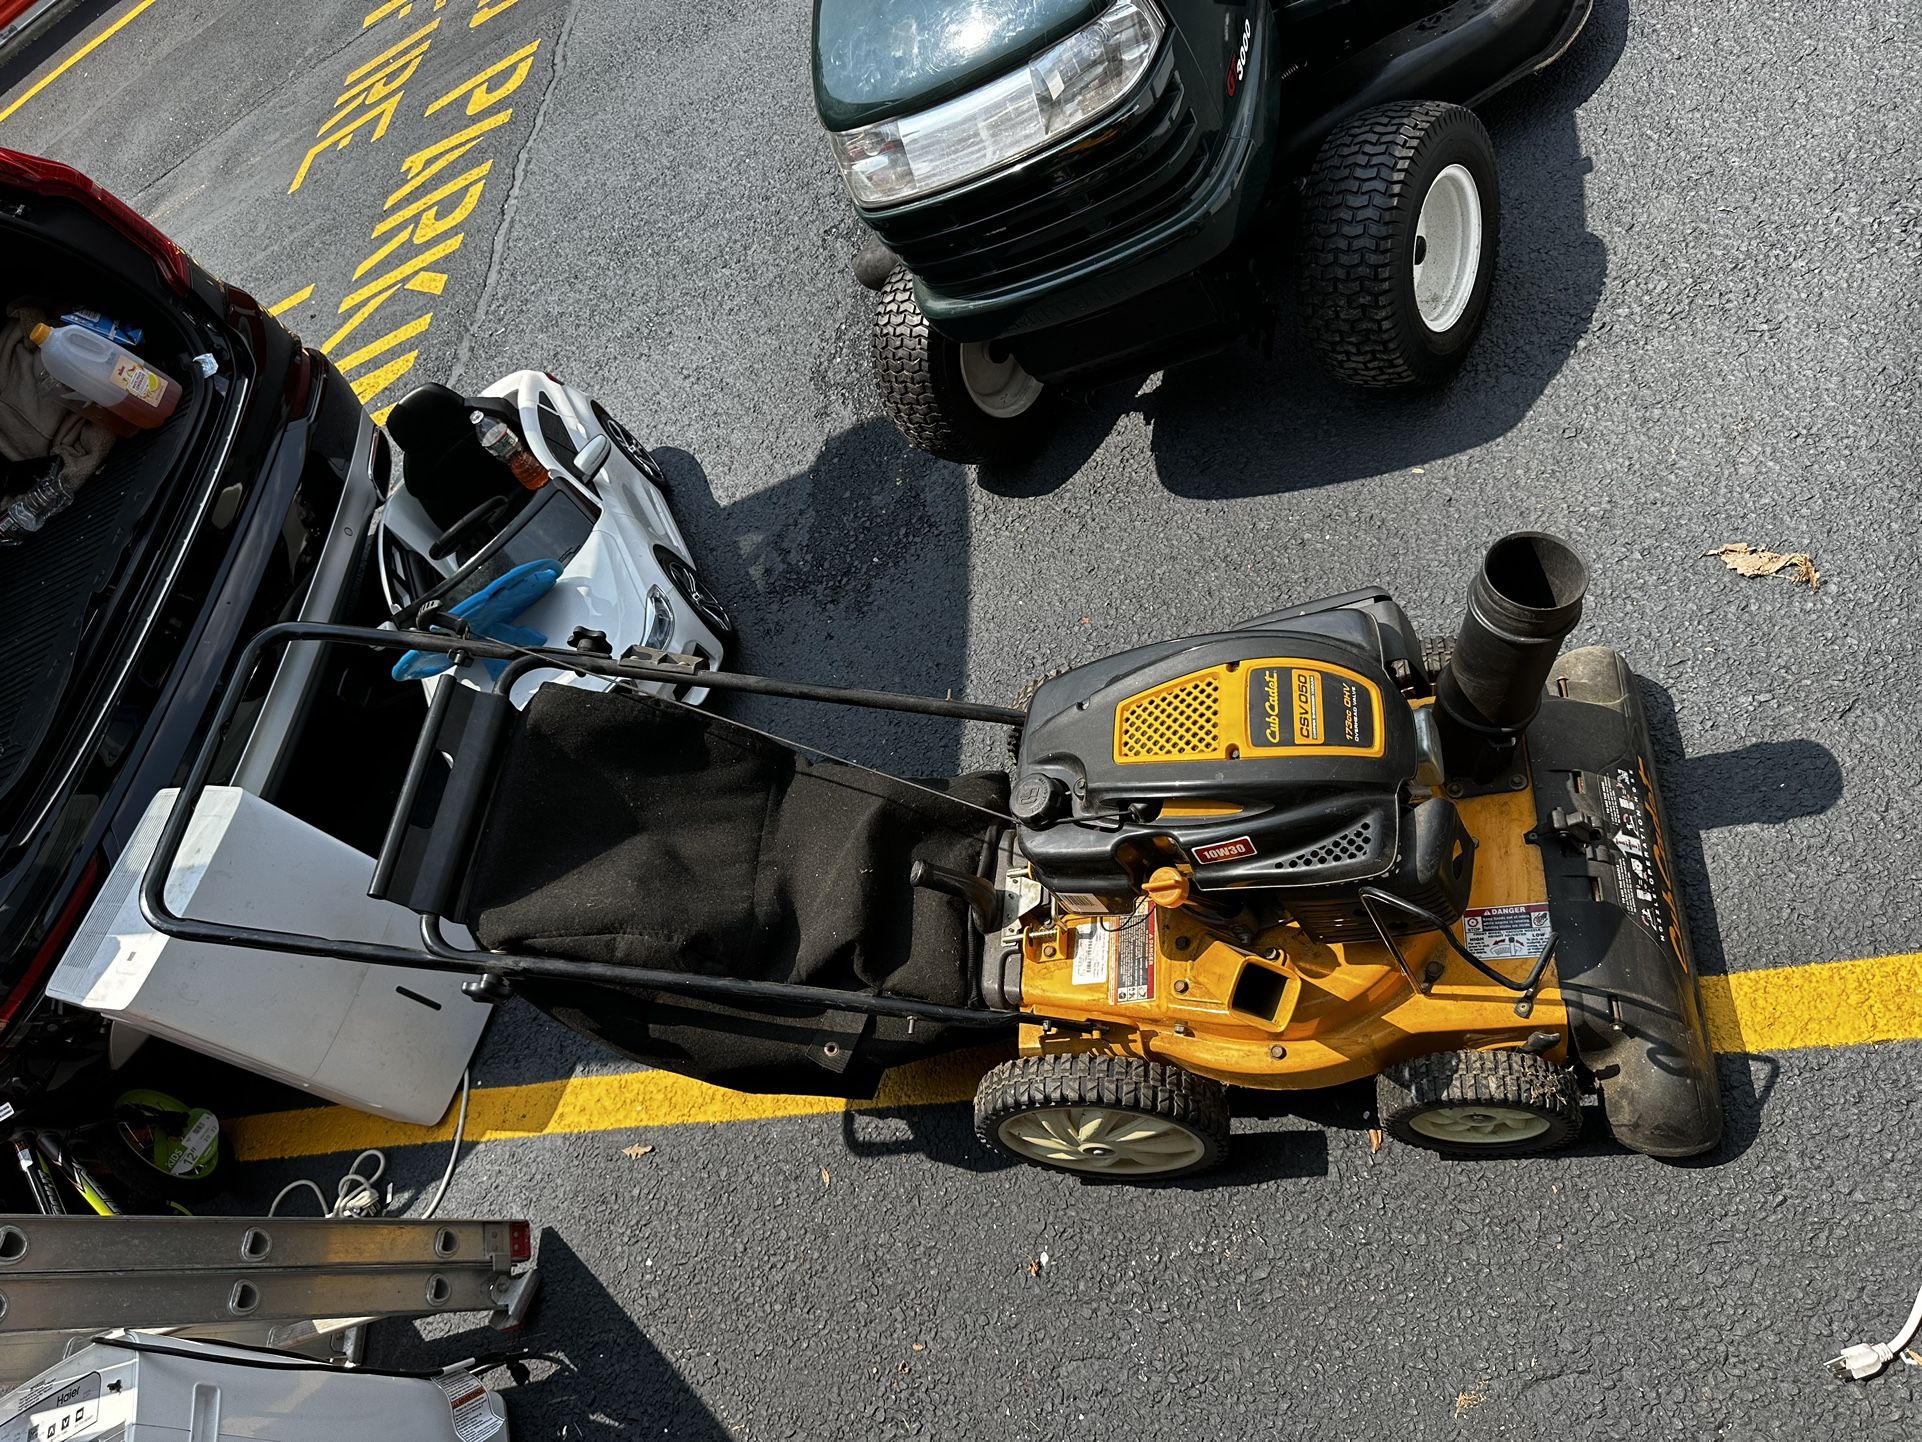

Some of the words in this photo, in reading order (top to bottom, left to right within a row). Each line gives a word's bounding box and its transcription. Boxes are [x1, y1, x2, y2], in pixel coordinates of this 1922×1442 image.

[1236, 18, 1250, 80] 3000
[1264, 670, 1278, 716] Cadet
[1298, 674, 1308, 704] 050
[1342, 683, 1352, 708] OHV
[1266, 715, 1280, 743] Cub
[1299, 704, 1310, 738] CSV
[1345, 710, 1353, 740] 173cc
[1638, 754, 1672, 890] Cadet
[1202, 844, 1246, 859] 10W30
[1636, 810, 1654, 885] OPERATION
[1492, 906, 1526, 915] DANGER
[1652, 893, 1666, 942] NOZZLE
[1662, 889, 1688, 974] Cub
[168, 1148, 182, 1168] KIDS
[56, 1386, 80, 1407] Haier
